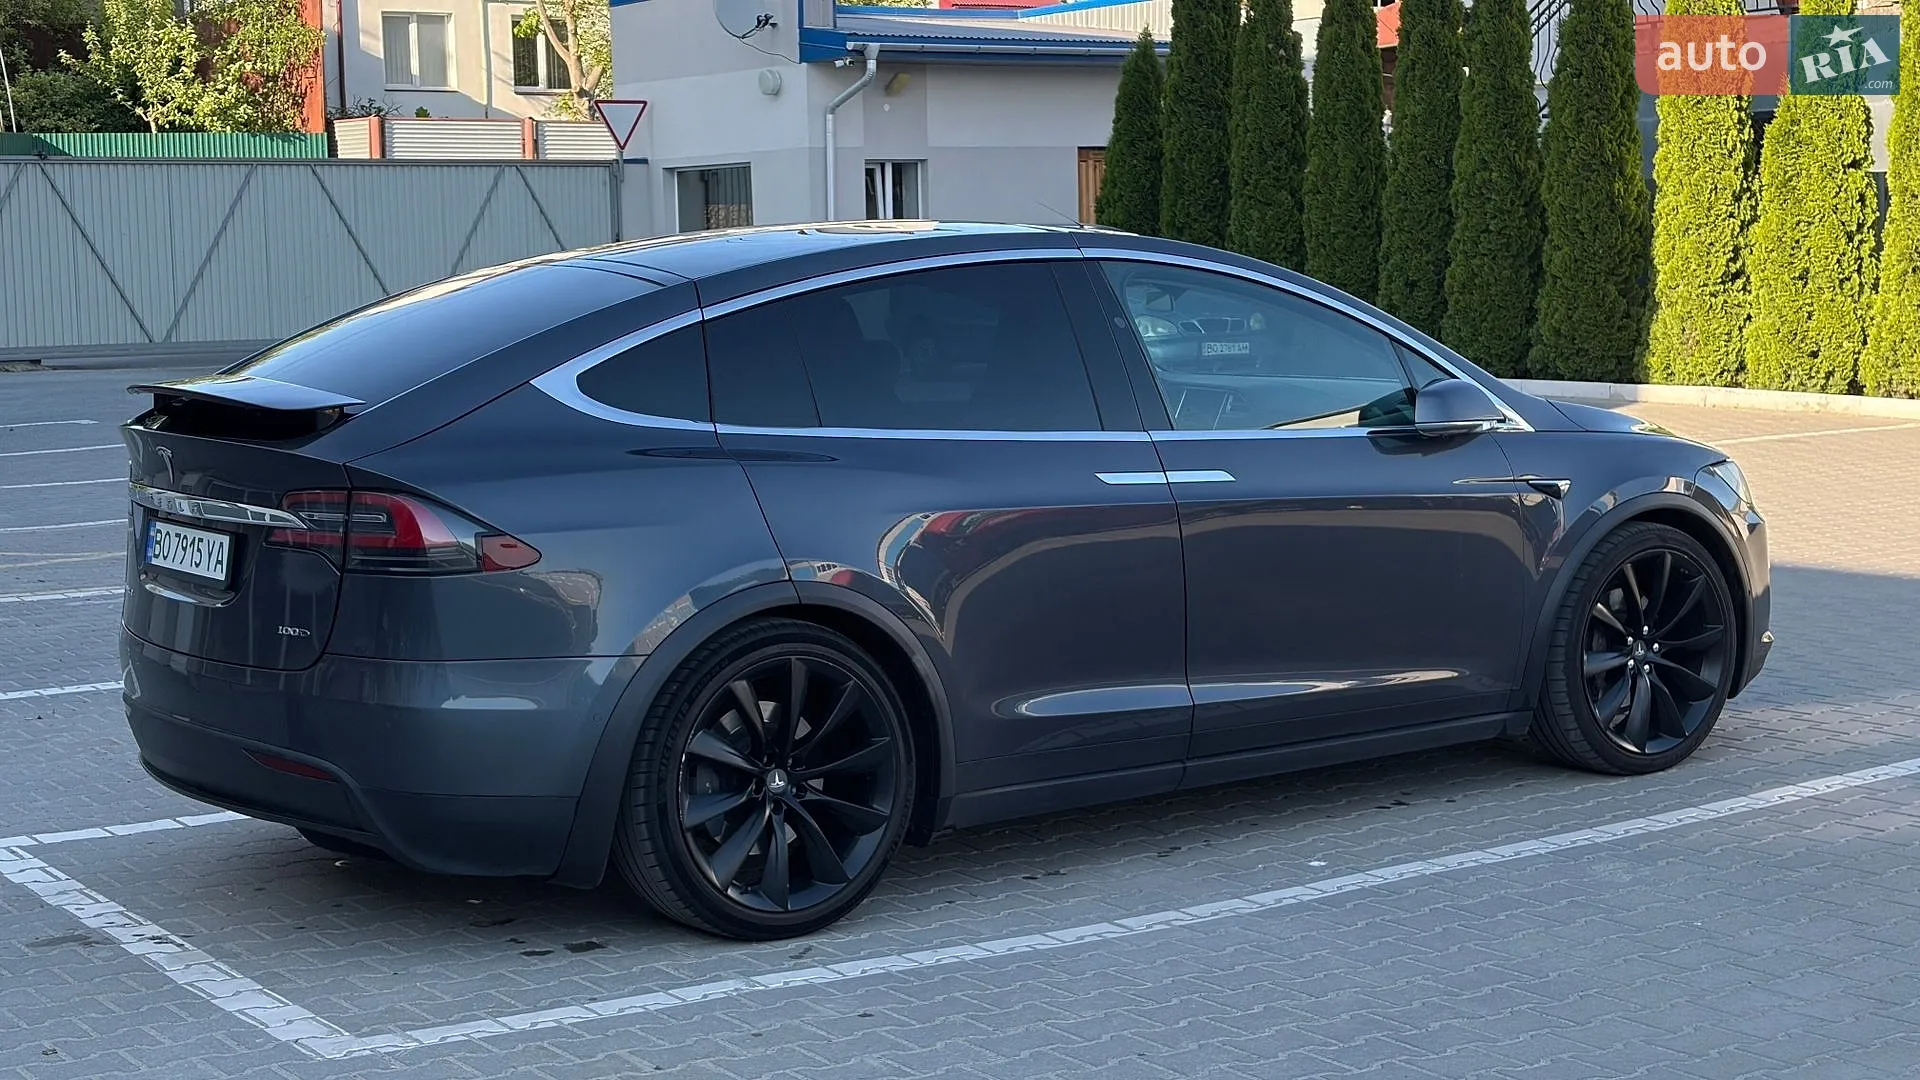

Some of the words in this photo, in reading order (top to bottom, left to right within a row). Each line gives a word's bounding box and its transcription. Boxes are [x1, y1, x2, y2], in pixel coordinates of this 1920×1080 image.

[153, 528, 171, 561] BO
[172, 532, 204, 568] 7915
[207, 539, 224, 574] YA
